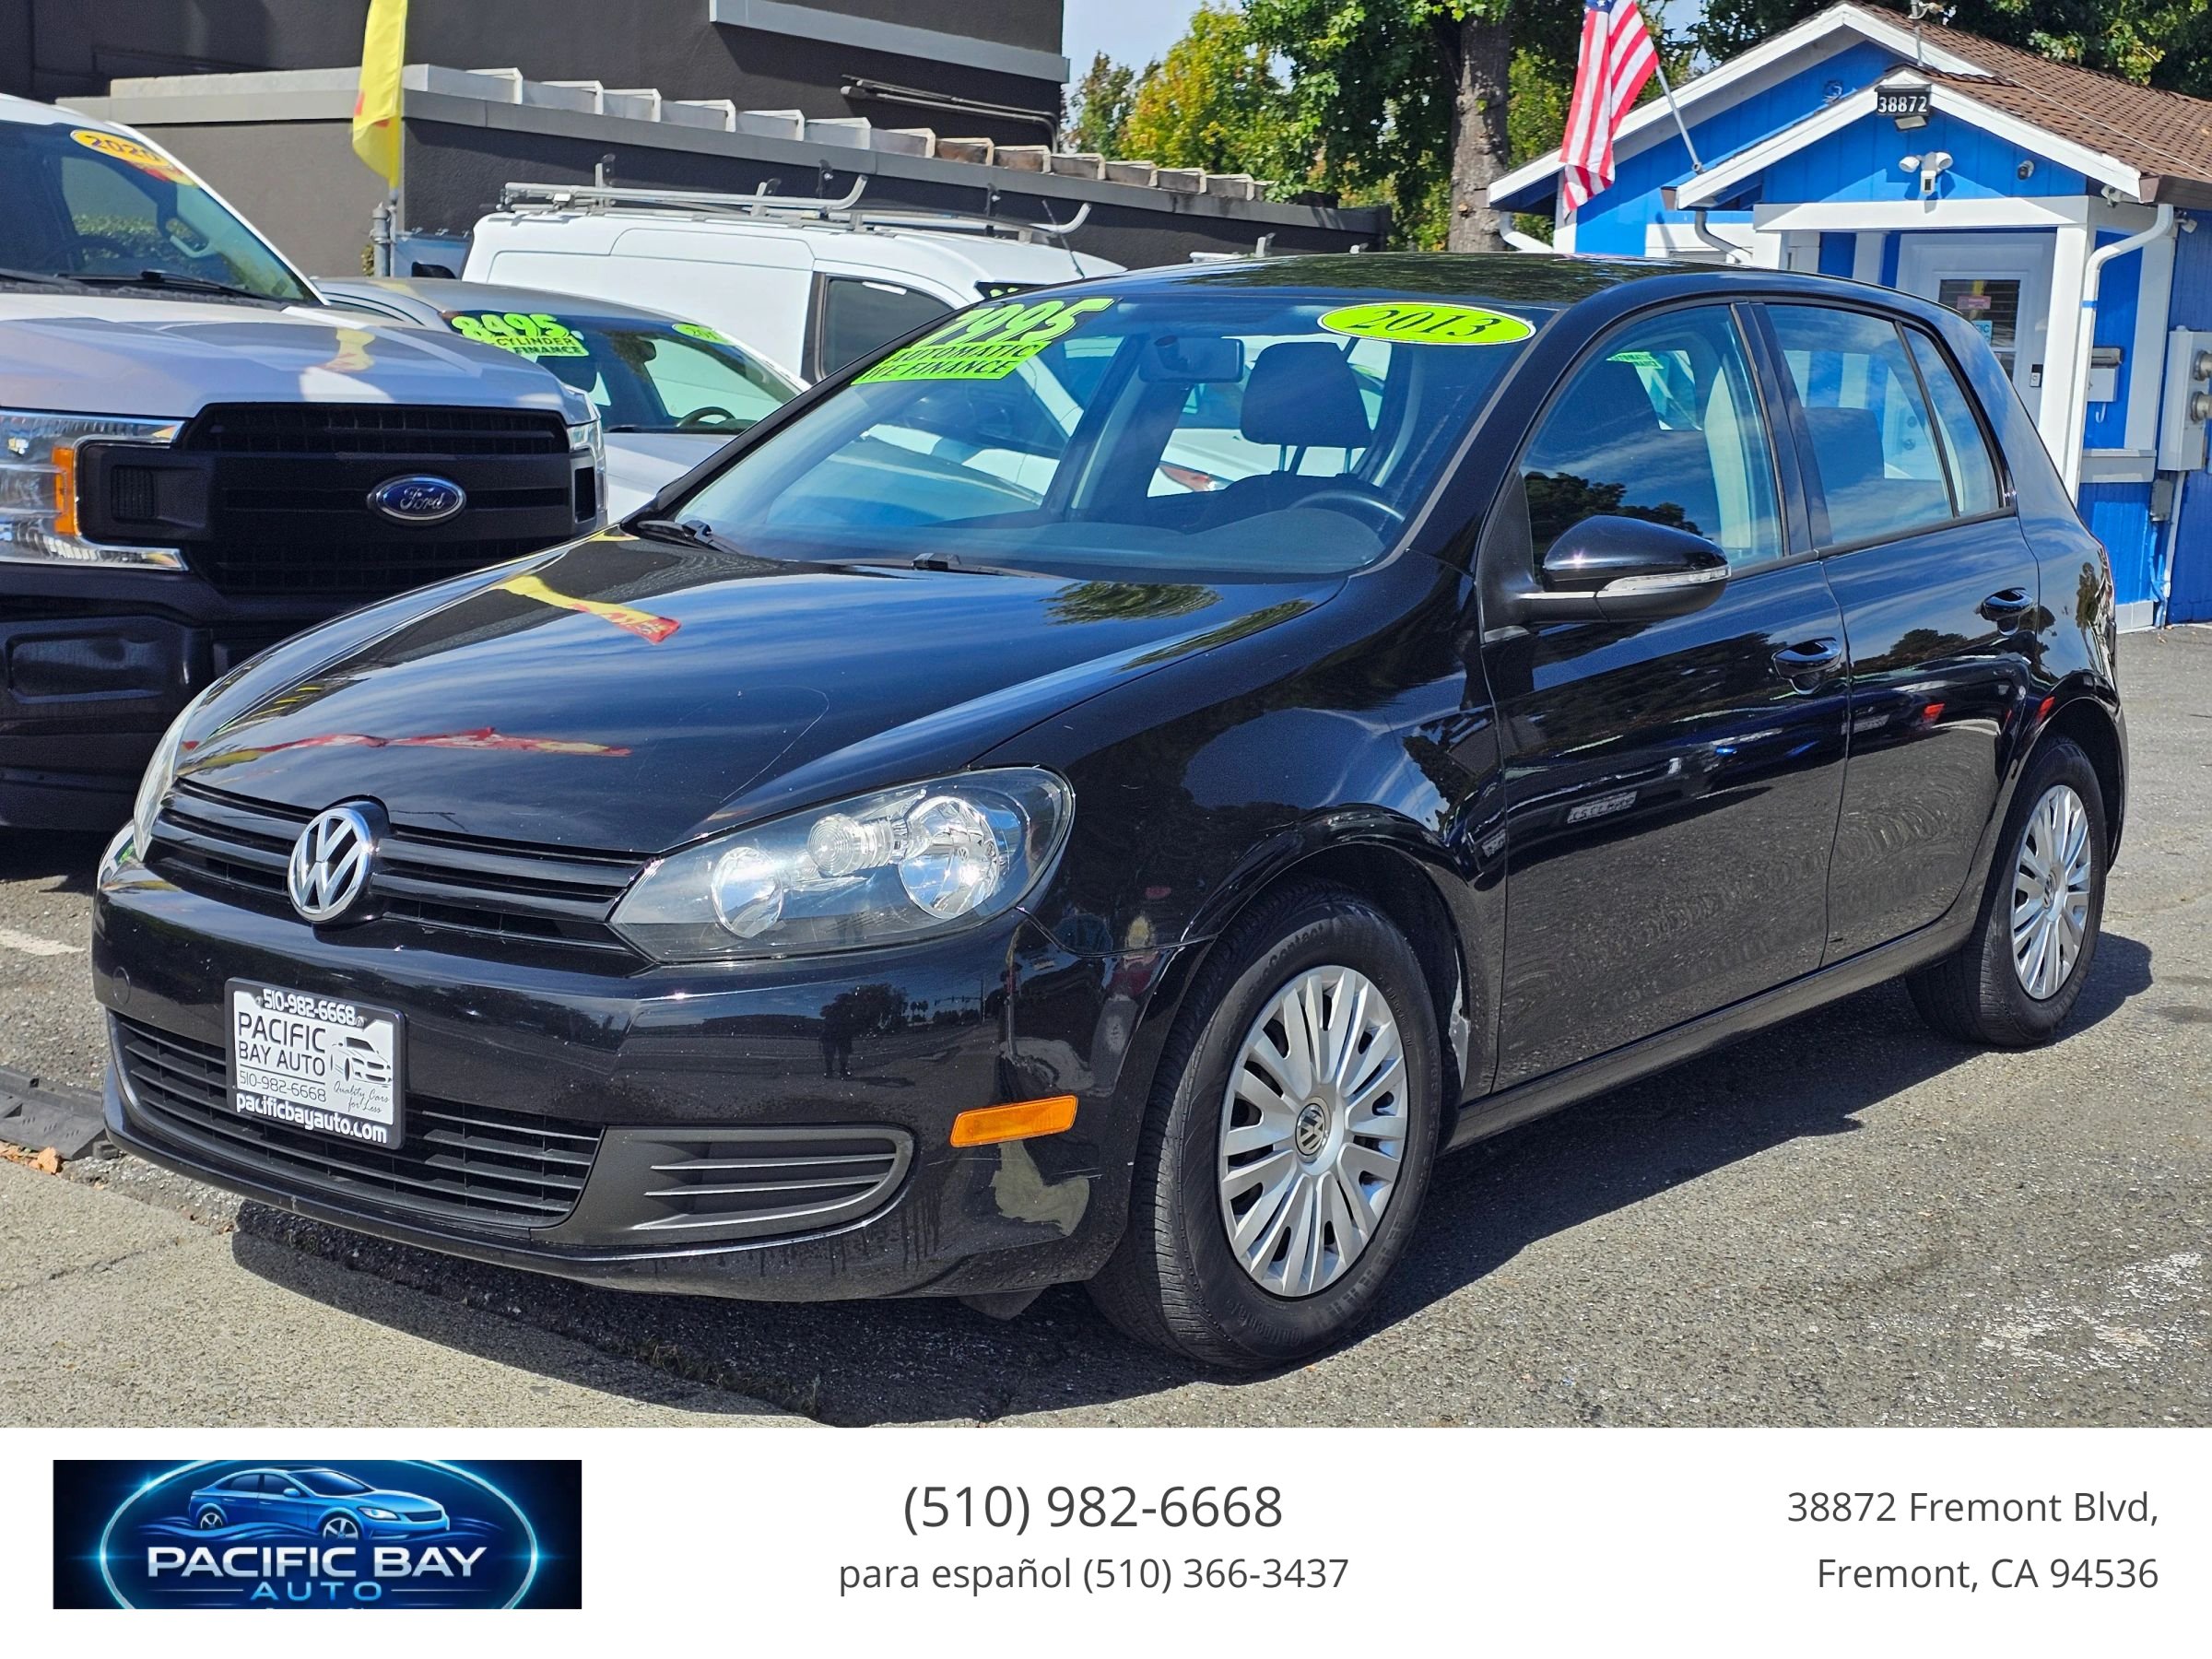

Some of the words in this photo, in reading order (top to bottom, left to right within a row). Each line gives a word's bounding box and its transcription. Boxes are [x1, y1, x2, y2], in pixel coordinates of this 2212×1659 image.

[1877, 96, 1927, 112] 38872
[1346, 310, 1502, 336] 2013
[496, 336, 576, 347] CYLINDER
[513, 347, 582, 356] FINANCE
[889, 342, 1034, 362] AUTOMATIC
[910, 359, 1015, 375] FINANCE
[400, 486, 444, 510] Ford
[262, 988, 357, 1026] 510-982-6668
[238, 1011, 326, 1054] PACIFIC
[238, 1041, 272, 1065] BAY
[276, 1049, 325, 1077] AUTO
[239, 1070, 327, 1102] 510-982-6668
[333, 1080, 365, 1105] Quality
[369, 1088, 390, 1103] Cars
[347, 1097, 359, 1112] for
[362, 1099, 382, 1113] Less
[236, 1092, 388, 1144] pacificbayauto.com
